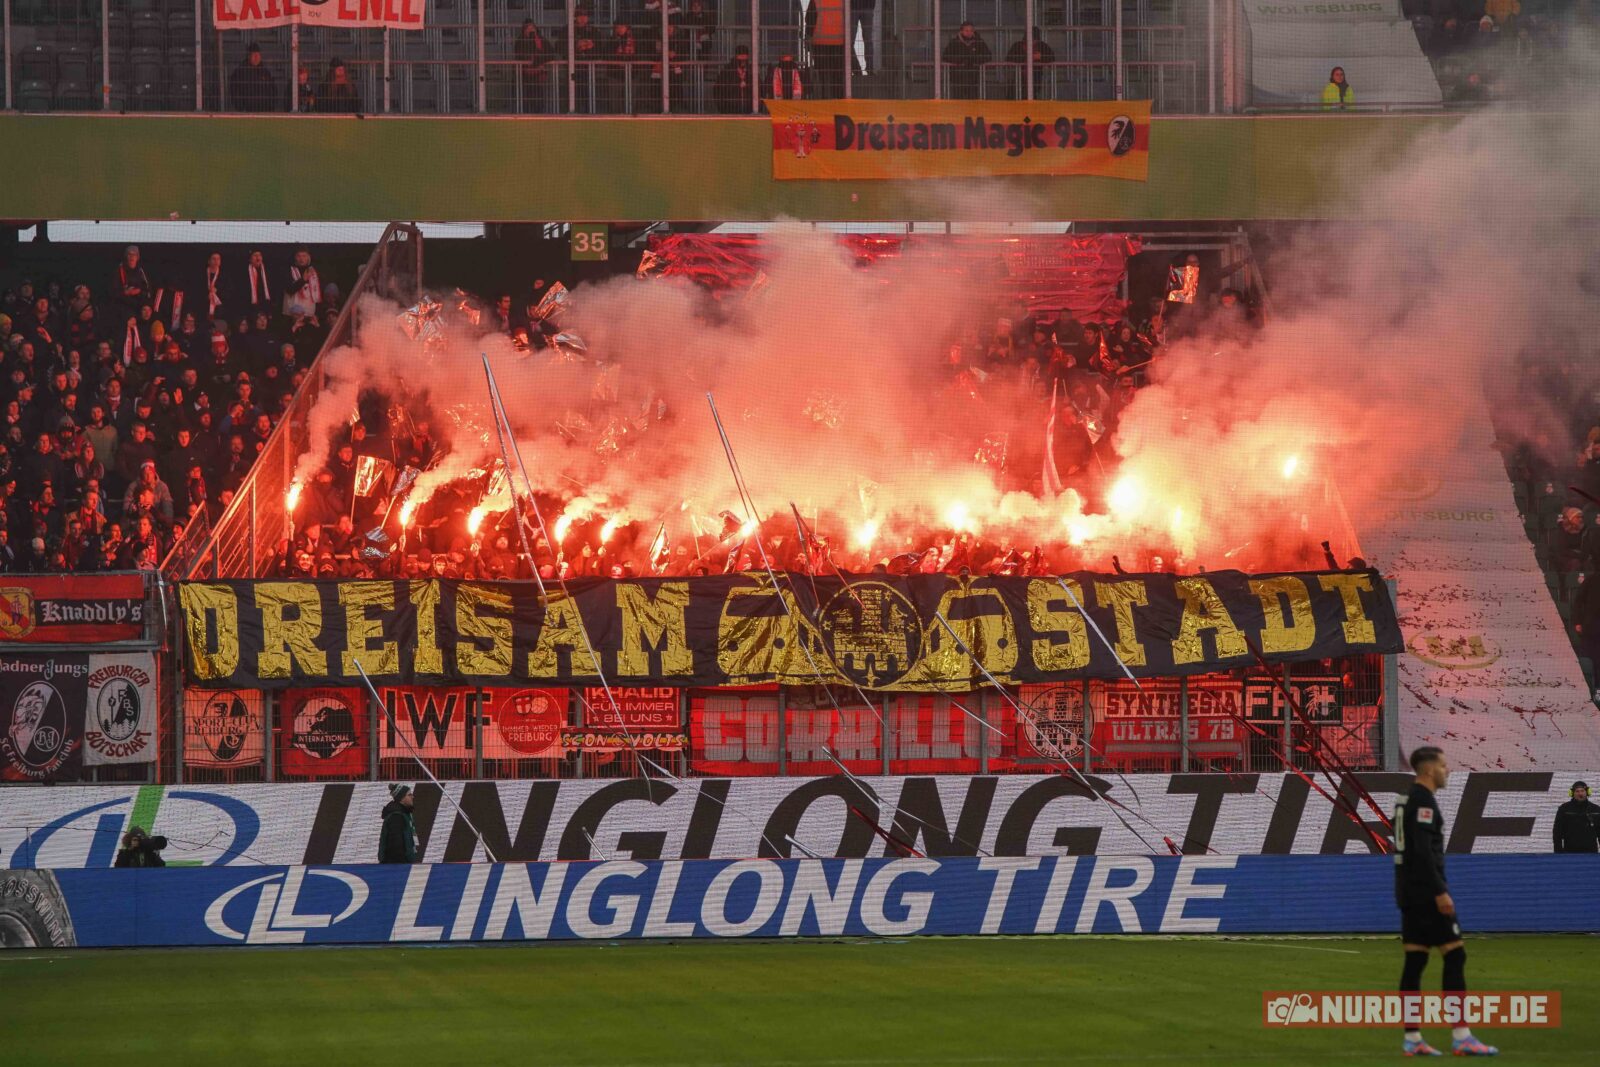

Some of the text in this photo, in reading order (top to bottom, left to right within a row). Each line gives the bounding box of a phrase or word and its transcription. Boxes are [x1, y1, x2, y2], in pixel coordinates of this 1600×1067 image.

[834, 113, 1088, 156] Dreisam Magic 95
[575, 232, 605, 252] 35
[40, 600, 142, 624] Knaddly's
[179, 573, 1376, 678] DREISAM STADT
[0, 661, 44, 674] adner
[88, 664, 150, 689] FREIBURGER
[626, 702, 674, 712] IMMER
[1106, 691, 1238, 715] SYNTHESIA
[630, 713, 663, 723] UNS
[298, 734, 350, 743] INTERNATIONAL
[509, 732, 552, 742] FREIBURG
[1112, 719, 1199, 741] ULTRAS
[85, 729, 152, 757] BOTSCHAFT
[389, 854, 1236, 942] LINGLONG TIRE
